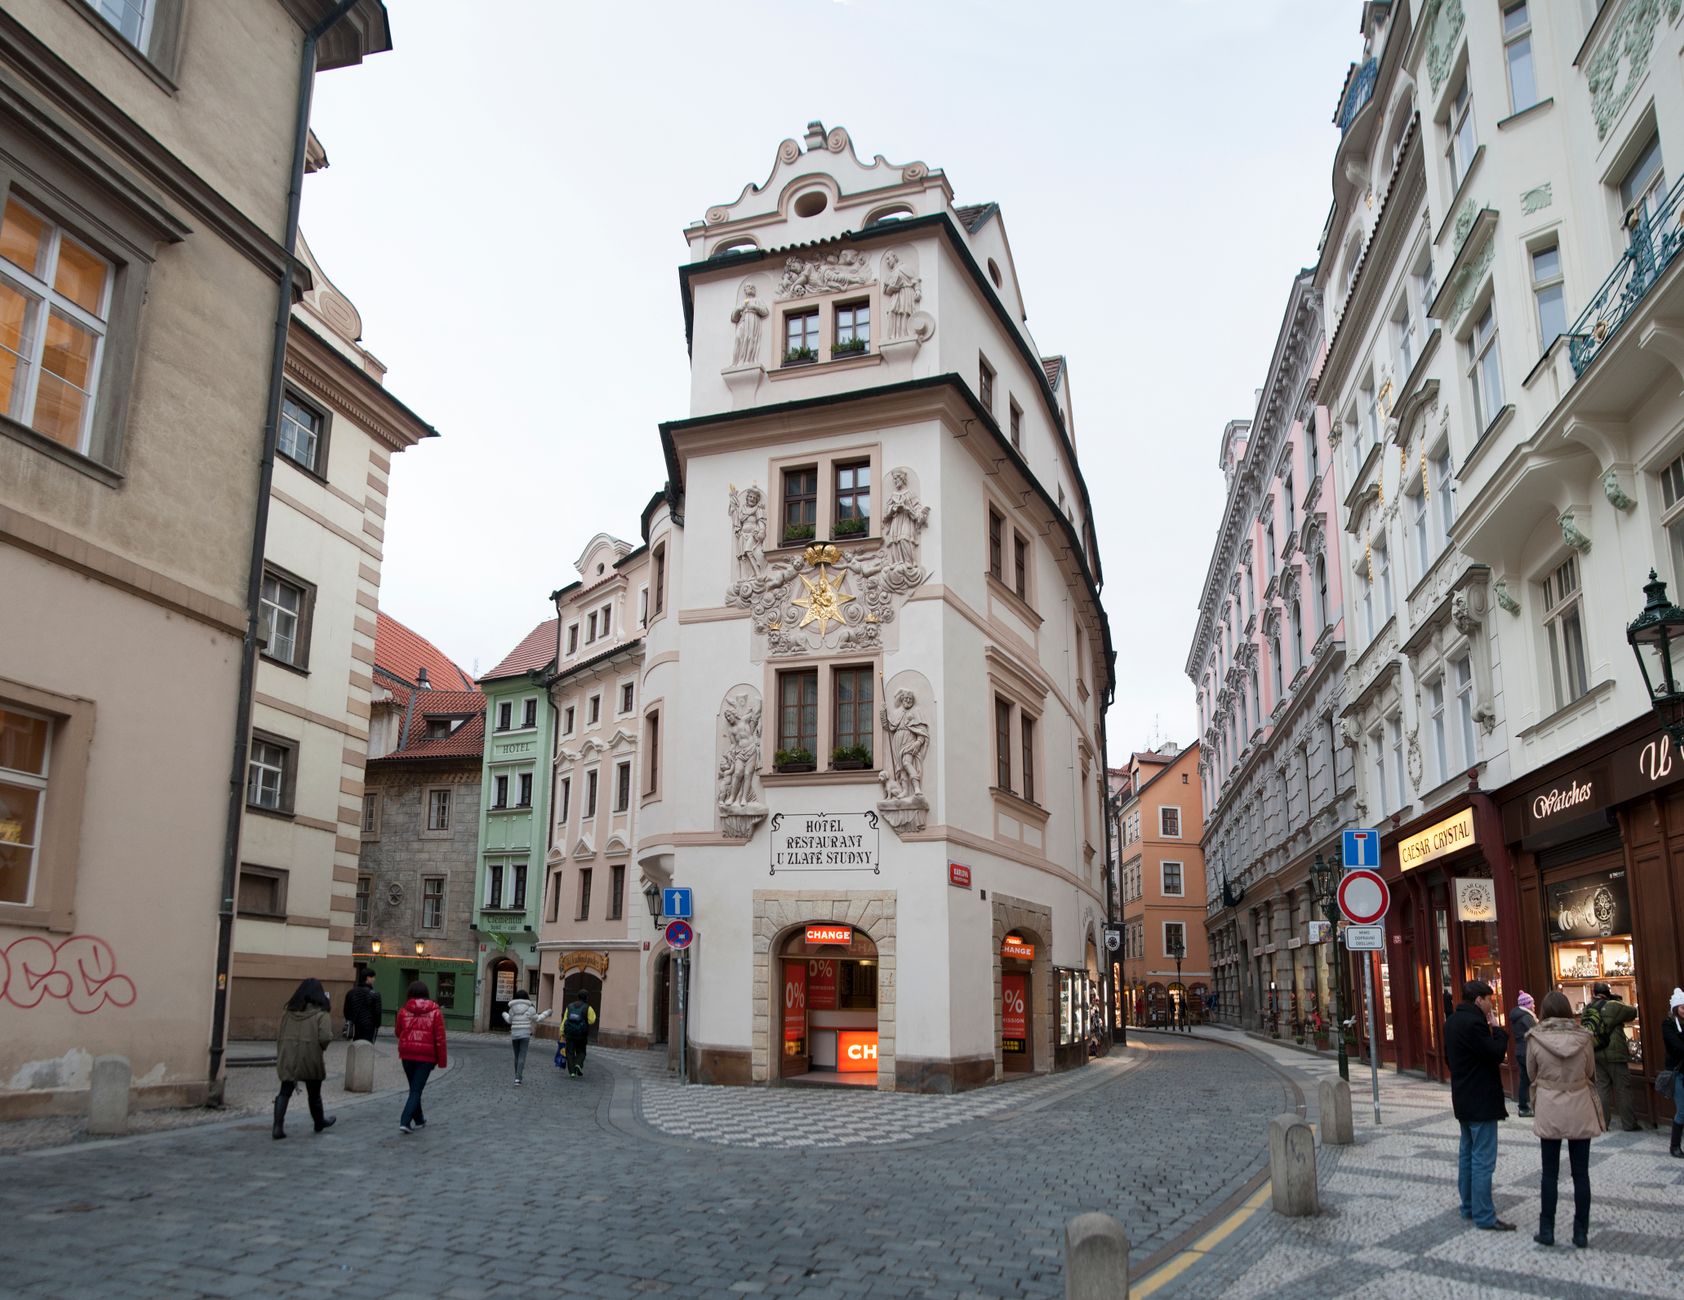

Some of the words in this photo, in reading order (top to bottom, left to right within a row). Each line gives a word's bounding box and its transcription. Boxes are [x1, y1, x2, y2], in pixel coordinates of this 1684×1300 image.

[502, 743, 530, 754] HOTEL
[1639, 734, 1672, 781] U
[1532, 780, 1592, 819] Watches
[806, 819, 844, 833] HOTEL
[786, 835, 862, 849] RESTAURANT
[1402, 838, 1431, 863] CAESAR
[1433, 821, 1470, 850] CRYSTAL
[776, 852, 785, 865] U
[787, 850, 823, 865] ZLATÉ
[826, 851, 872, 865] STUDNY
[806, 930, 851, 940] CHANGE
[809, 959, 833, 978] 0%
[785, 981, 805, 1009] 0%
[847, 1044, 877, 1060] CH
